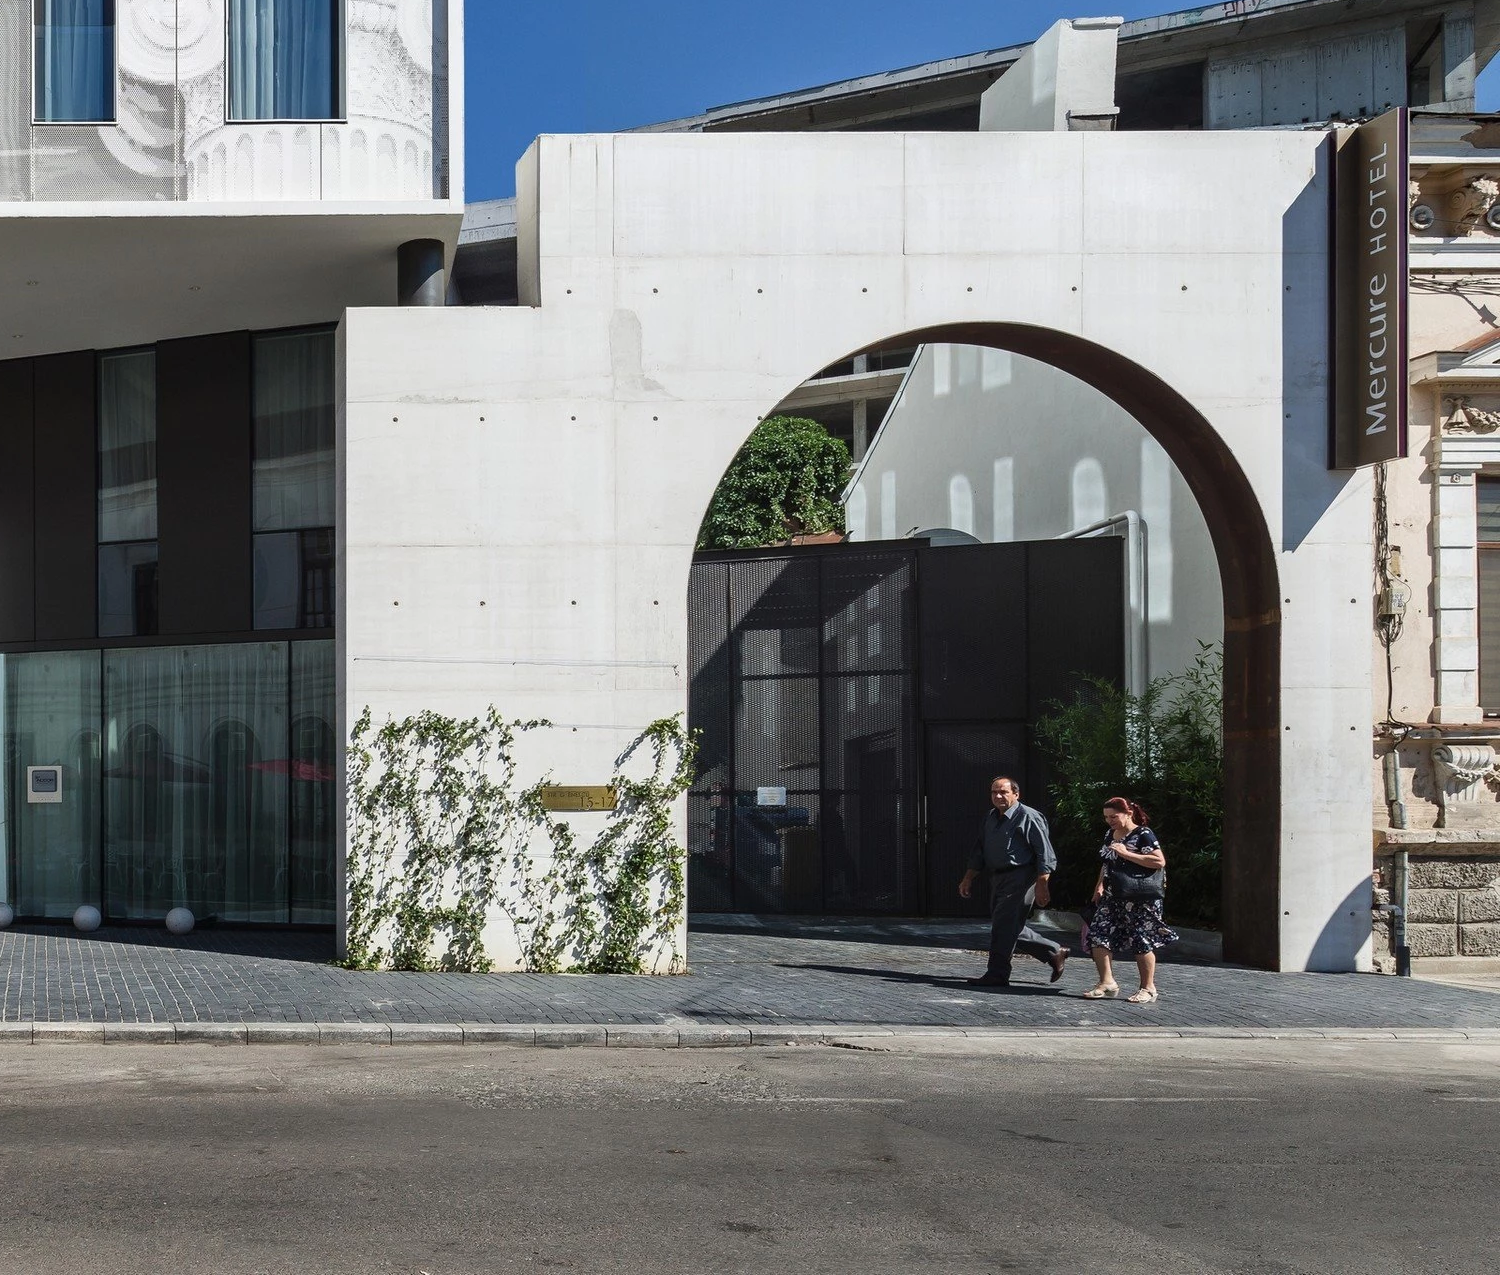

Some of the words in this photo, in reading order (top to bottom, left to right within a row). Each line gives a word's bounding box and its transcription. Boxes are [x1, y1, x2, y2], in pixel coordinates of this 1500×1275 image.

[1369, 142, 1388, 255] HOTEL
[1365, 273, 1387, 436] Mercure
[580, 797, 615, 808] 15-17
